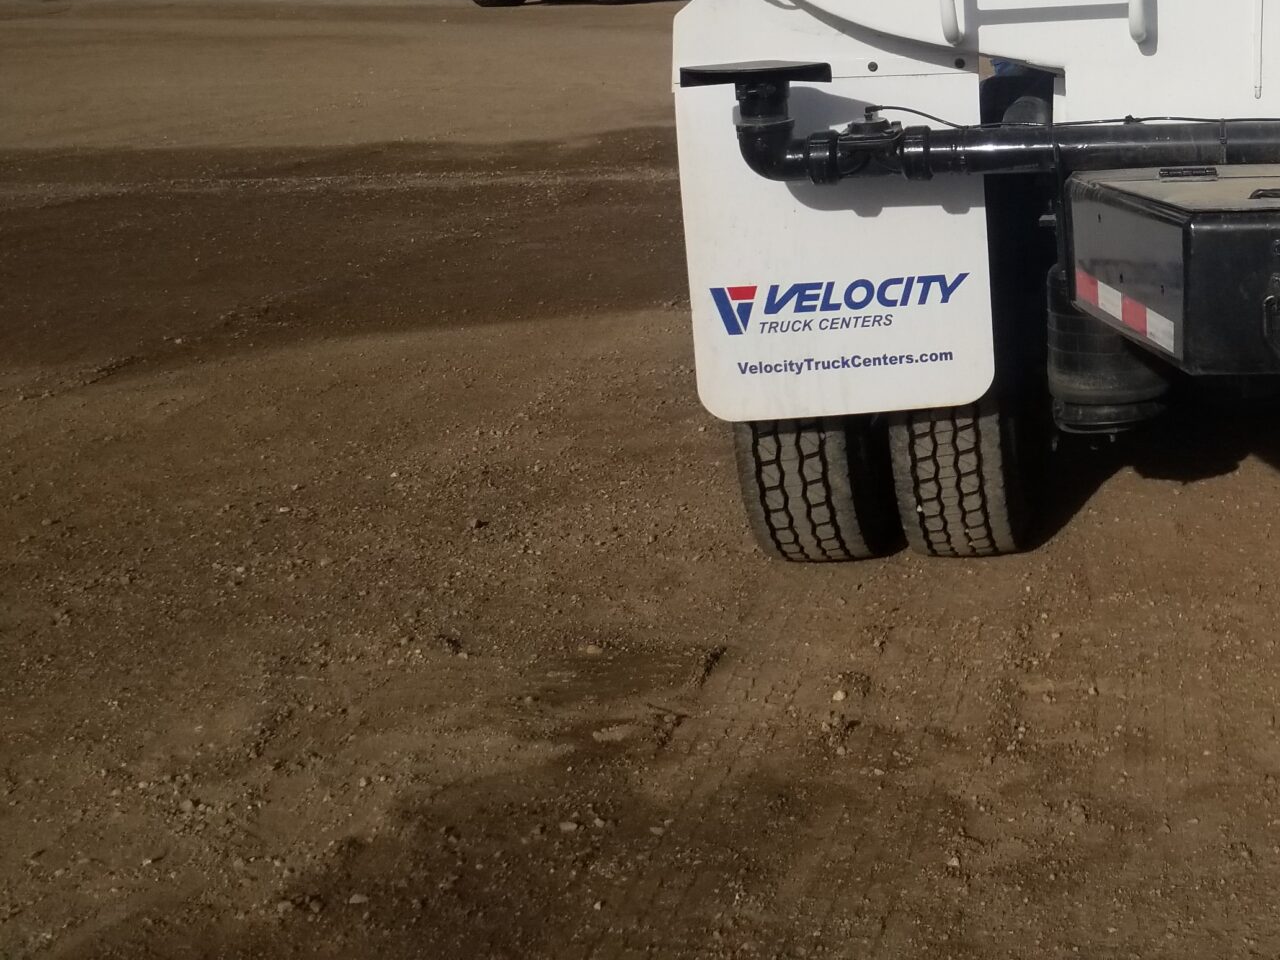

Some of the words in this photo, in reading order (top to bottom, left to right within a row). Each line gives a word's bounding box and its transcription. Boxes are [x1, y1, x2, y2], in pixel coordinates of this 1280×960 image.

[763, 272, 970, 315] VELOCITY
[759, 318, 813, 334] TRUCK
[818, 314, 894, 331] CENTERS
[737, 350, 954, 375] VelocityTruckCenters.com
